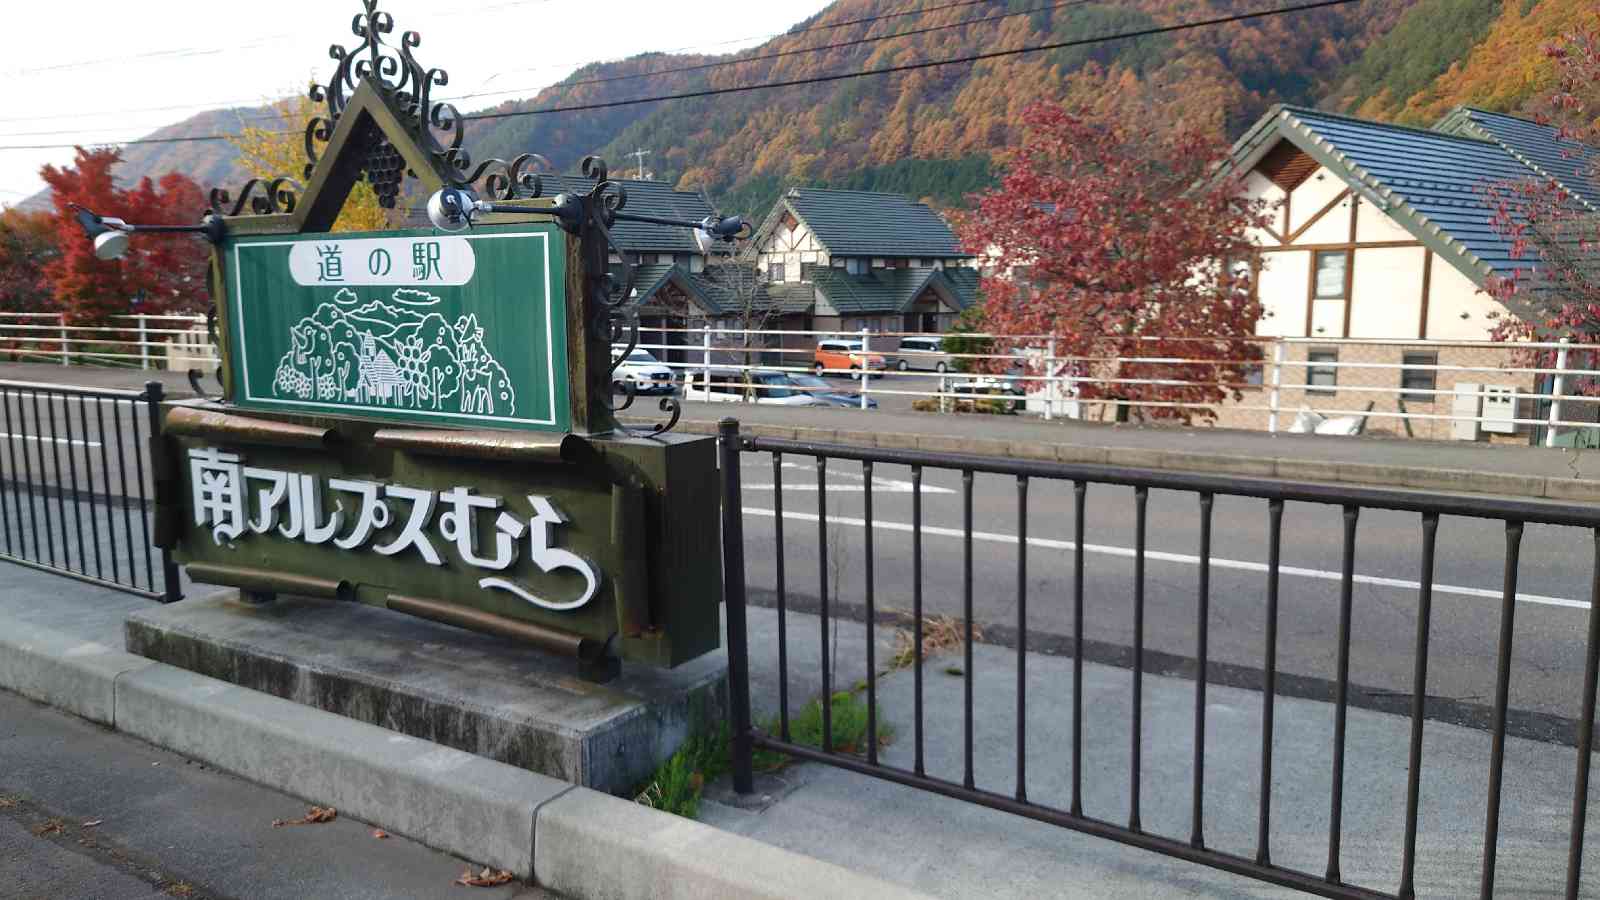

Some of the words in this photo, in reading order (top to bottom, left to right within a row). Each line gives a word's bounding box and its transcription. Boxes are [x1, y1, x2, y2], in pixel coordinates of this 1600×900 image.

[317, 242, 442, 281] 道の駅
[188, 446, 598, 611] 南アルプスむら
